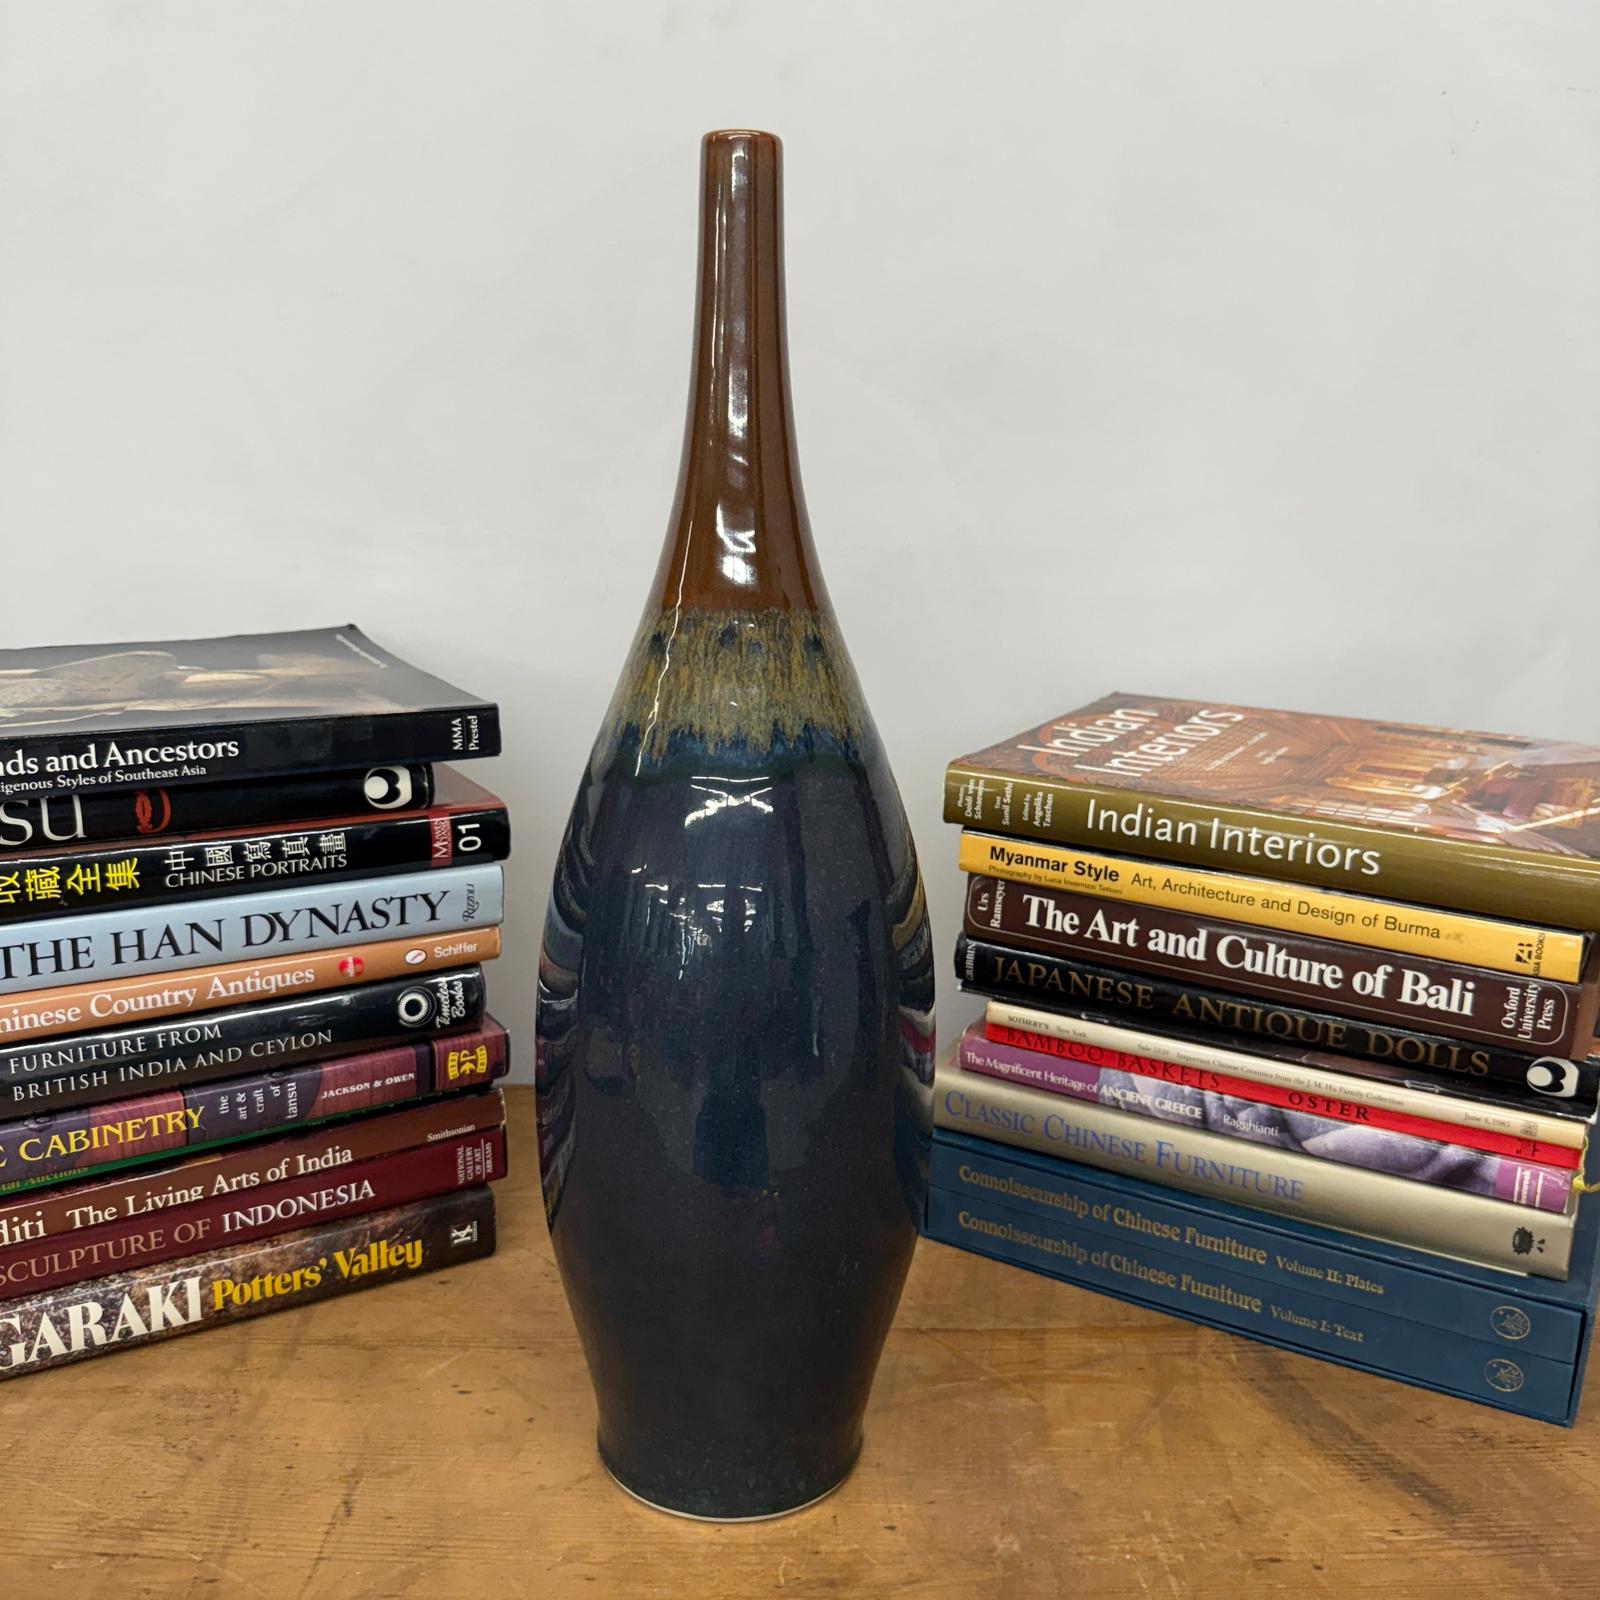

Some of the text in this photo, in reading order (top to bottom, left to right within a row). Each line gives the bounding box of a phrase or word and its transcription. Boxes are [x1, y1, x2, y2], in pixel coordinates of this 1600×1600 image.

[451, 717, 463, 750] MMA
[467, 715, 480, 751] Prestel
[1017, 707, 1159, 757] Indian
[1074, 709, 1244, 777] Interiors
[45, 743, 98, 773] and
[103, 740, 239, 769] Ancestors
[57, 774, 96, 791] Styles
[99, 771, 113, 785] of
[115, 767, 179, 783] Southeast
[181, 764, 207, 777] Asia
[1002, 804, 1011, 826] Sunil
[1033, 791, 1044, 827] Angelika
[1043, 793, 1054, 828] Taschen
[458, 823, 482, 852] 01
[1087, 798, 1381, 876] Indian Interiors
[165, 854, 347, 888] CHINESE PORTRAITS
[977, 892, 989, 911] Urs
[989, 845, 1068, 874] Myanmar
[1073, 860, 1120, 882] Style
[1162, 879, 1255, 910] Architecture
[1260, 898, 1291, 913] and
[1297, 900, 1355, 925] Design
[1361, 912, 1379, 928] of
[1384, 915, 1441, 940] Burma
[990, 879, 1005, 929] Ramseyer
[0, 890, 450, 980] THE HAN DYNASTY
[434, 942, 478, 959] Schiffer
[964, 941, 976, 981] GRIBBIN
[1022, 894, 1475, 1017] The Art and Culture of Bali
[90, 987, 198, 1018] Country
[206, 968, 315, 1000] Antiques
[1500, 987, 1521, 1030] Oxford
[1517, 981, 1542, 1040] University
[993, 956, 1490, 1077] JAPANESE ANTIQUE DOLLS
[1536, 998, 1556, 1031] Press
[9, 1023, 222, 1074] FURNITURE FROM
[12, 1029, 333, 1102] BRITISH INDIA AND CEYLON
[1007, 1027, 1220, 1089] BAMBOO BASKETS
[1176, 1051, 1211, 1066] Important
[1212, 1059, 1239, 1071] Chinese
[218, 1094, 230, 1116] the
[236, 1091, 248, 1121] art &
[251, 1087, 265, 1114] craft
[321, 1072, 415, 1100] JACKSON & OWEN
[965, 1051, 1279, 1137] The Magnificent Heritage of ANCIENT GREECE Ragghianti
[1288, 1092, 1370, 1121] OSTER
[19, 1105, 205, 1162] CABINETRY
[427, 1123, 476, 1142] Smithsonian
[457, 1145, 465, 1185] NATIONAL
[66, 1205, 118, 1229] The
[125, 1186, 204, 1217] Living
[212, 1169, 260, 1195] Arts
[266, 1158, 291, 1181] of
[296, 1145, 353, 1174] India
[0, 1179, 376, 1286] SCULPTURE OF INDONESIA
[959, 1164, 1089, 1220] Connoisseurship
[1093, 1204, 1111, 1221] of
[1113, 1207, 1179, 1242] Chinese
[1185, 1226, 1267, 1265] Furniture
[1275, 1255, 1324, 1280] Volume
[1345, 1274, 1385, 1295] Plates
[334, 1239, 424, 1279] Valley
[958, 1211, 1087, 1266] Connoisseurship
[1091, 1250, 1110, 1267] of
[1109, 1254, 1177, 1289] Chinese
[1180, 1273, 1263, 1313] Furniture
[1270, 1305, 1318, 1330] Volume
[1333, 1324, 1364, 1343] Text
